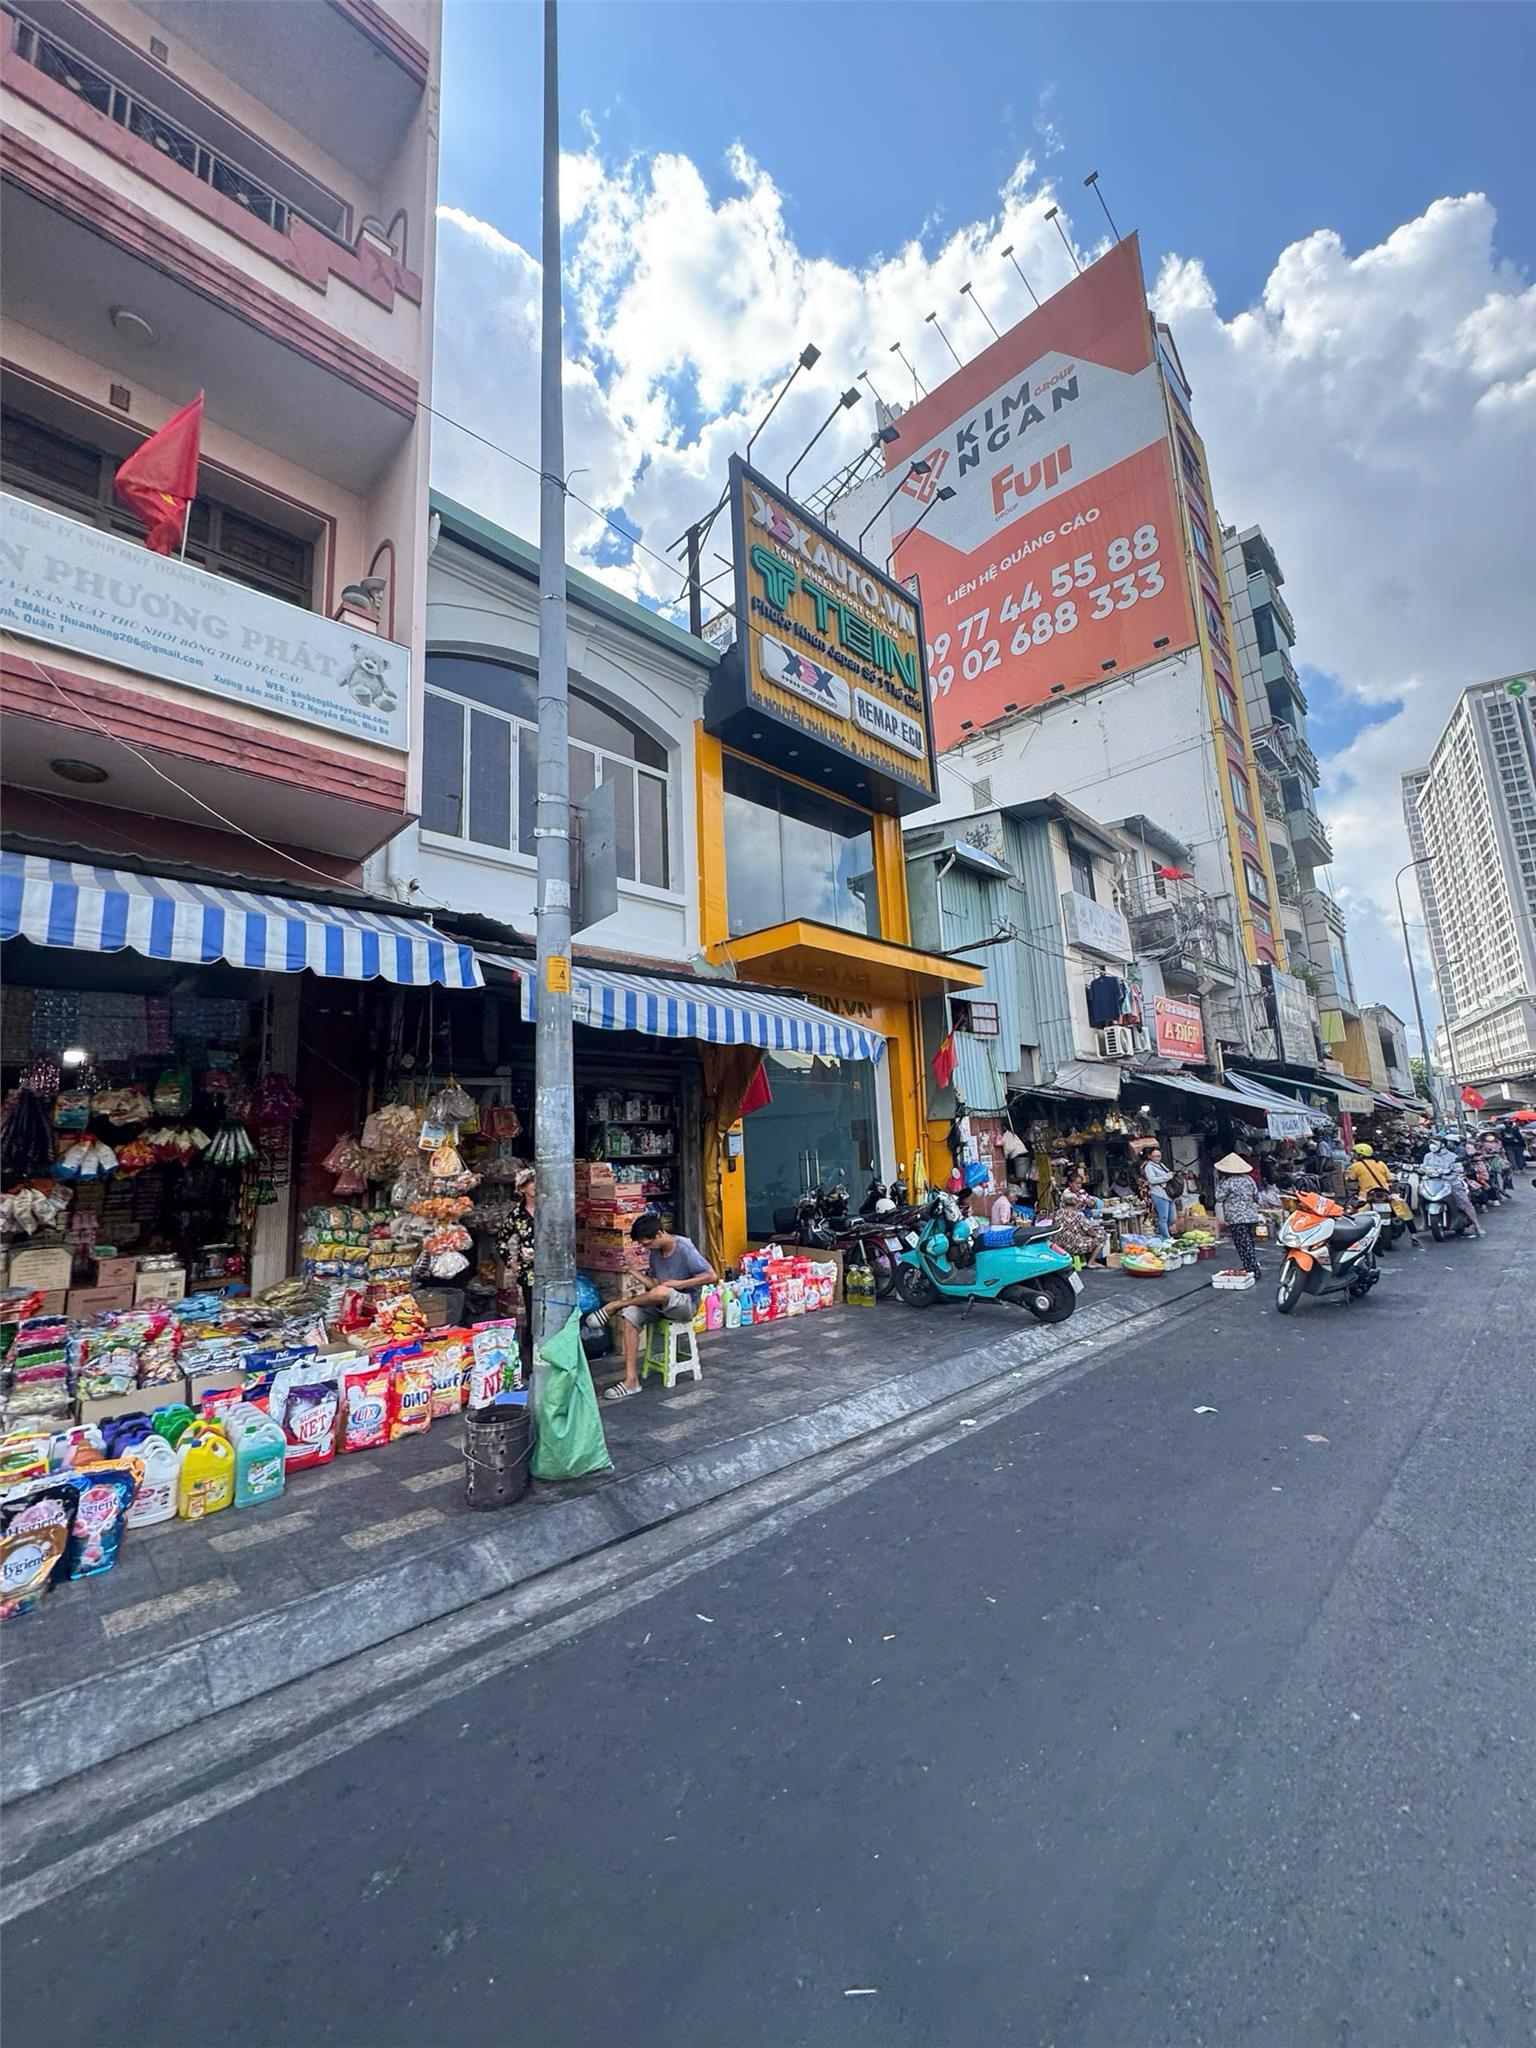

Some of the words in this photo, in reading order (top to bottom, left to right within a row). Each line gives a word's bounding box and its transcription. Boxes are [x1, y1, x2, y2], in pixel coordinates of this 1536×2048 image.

[956, 381, 1031, 453] KIM
[1034, 364, 1076, 397] GROUP
[958, 375, 1079, 478] NGAN
[995, 503, 1019, 521] GROUP
[774, 544, 800, 570] TONY
[803, 565, 835, 594] WHEEL
[835, 587, 865, 616] SPORT
[946, 578, 977, 605] LIÊN
[979, 563, 999, 587] HỆ
[1000, 529, 1057, 572] QUẢNG
[1059, 507, 1101, 536] CÁO
[957, 607, 991, 650] 77
[999, 580, 1043, 624] 44
[1050, 552, 1097, 598] 55
[1107, 523, 1160, 573] 88
[14, 598, 57, 619] EMAIL:
[60, 613, 204, 668] thuanhung206@gmail.com
[23, 612, 55, 631] Quận
[41, 554, 231, 641] PHƯƠNG
[240, 624, 338, 679] PHÁT
[962, 639, 1002, 681] 02
[1010, 600, 1079, 657] 688
[1088, 560, 1165, 620] 333
[180, 637, 217, 656] BÔNG
[219, 650, 252, 668] THEO
[256, 662, 279, 676] YÊU
[265, 679, 290, 695] WEB:
[857, 695, 899, 737] REMAP
[901, 721, 923, 752] ECU
[559, 969, 565, 980] 4
[299, 1414, 327, 1441] NET
[403, 1390, 429, 1409] OMO
